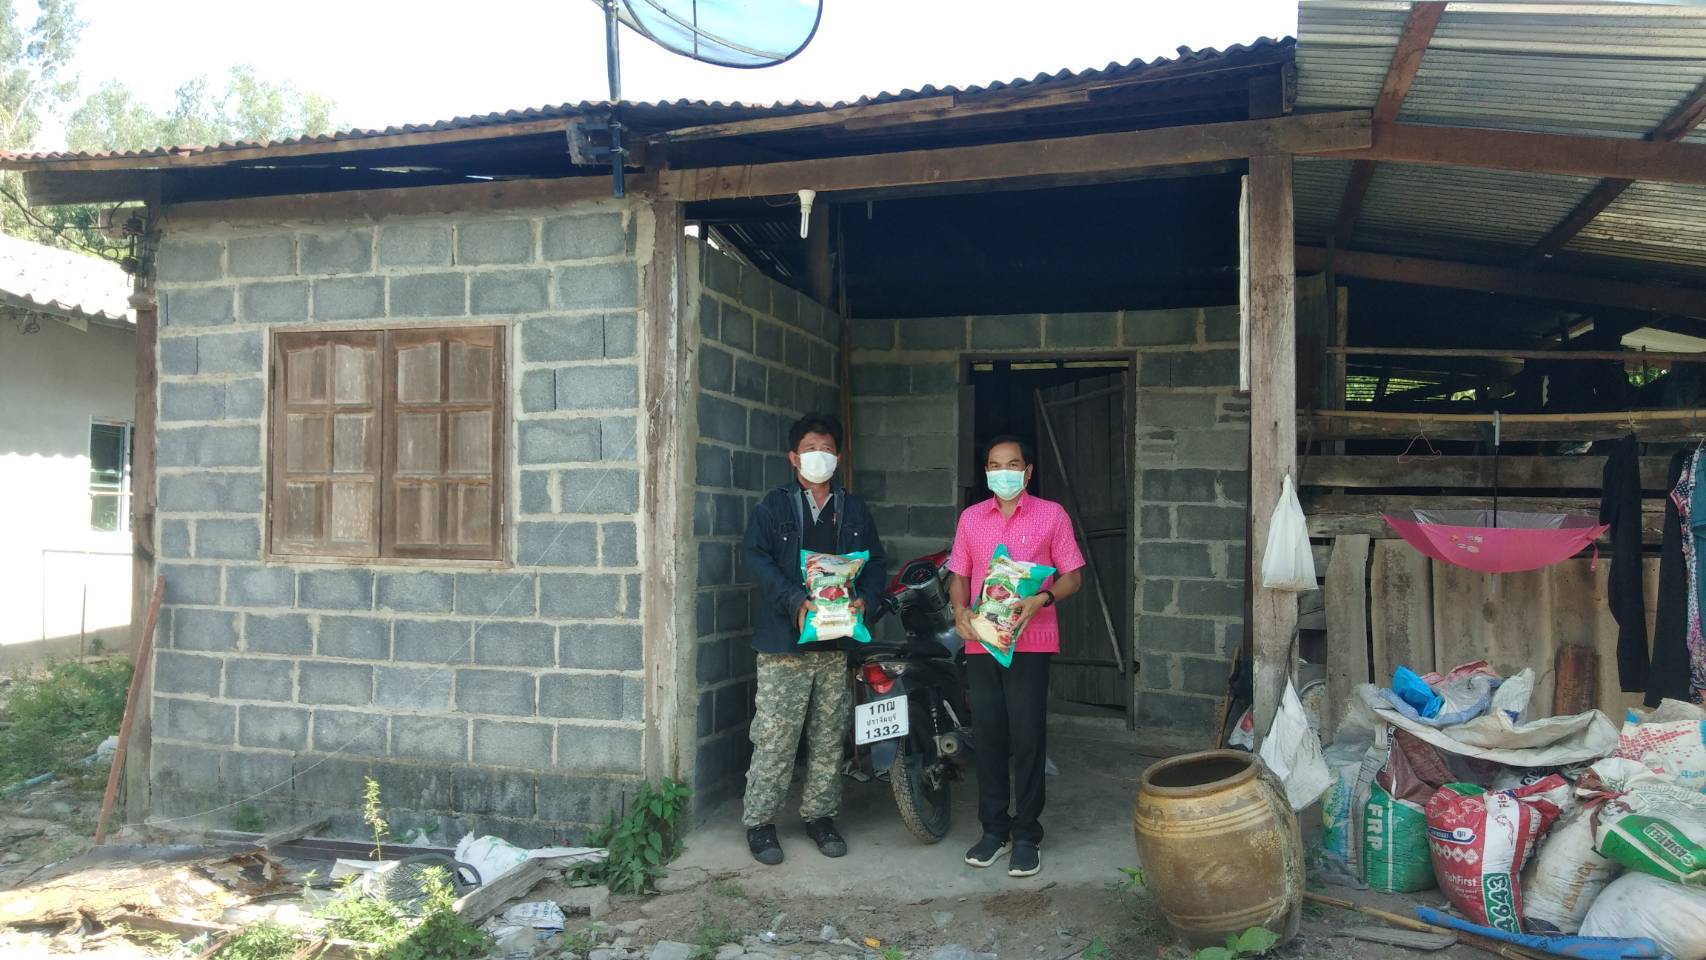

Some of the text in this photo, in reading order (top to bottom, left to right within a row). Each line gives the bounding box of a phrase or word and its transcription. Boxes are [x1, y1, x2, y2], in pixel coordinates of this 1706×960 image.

[865, 723, 900, 740] 1332
[1366, 802, 1384, 852] FRP
[1444, 871, 1477, 886] FishFirst
